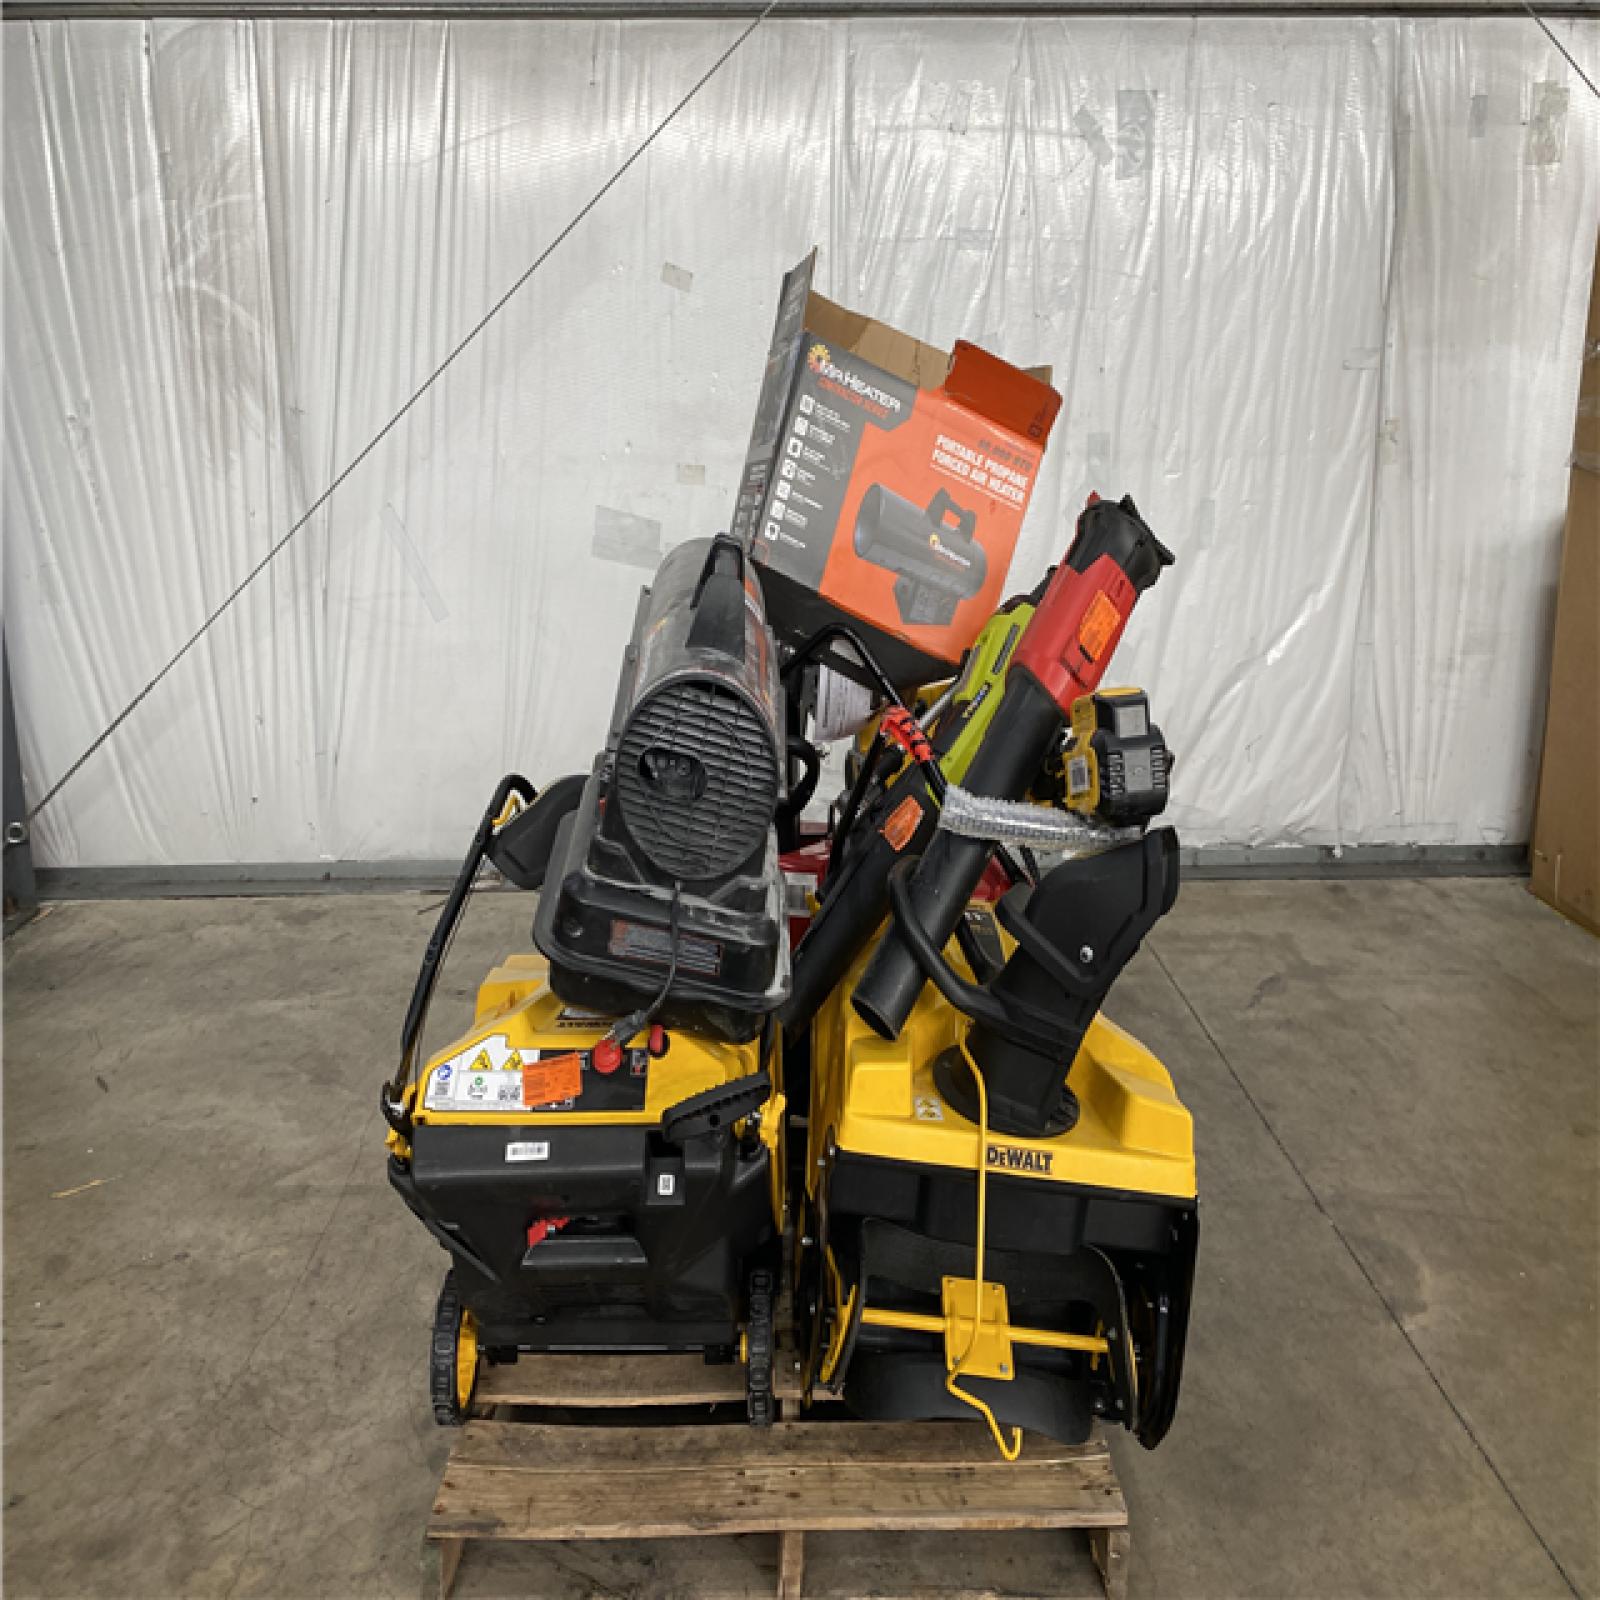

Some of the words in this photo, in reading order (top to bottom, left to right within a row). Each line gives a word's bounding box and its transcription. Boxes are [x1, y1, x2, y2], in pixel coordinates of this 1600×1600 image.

[932, 449, 970, 476] FORCED
[988, 478, 1025, 503] HEATER
[934, 434, 984, 466] PORTABLE
[984, 458, 1028, 488] PROPANE
[986, 1145, 1053, 1175] DEWALT
